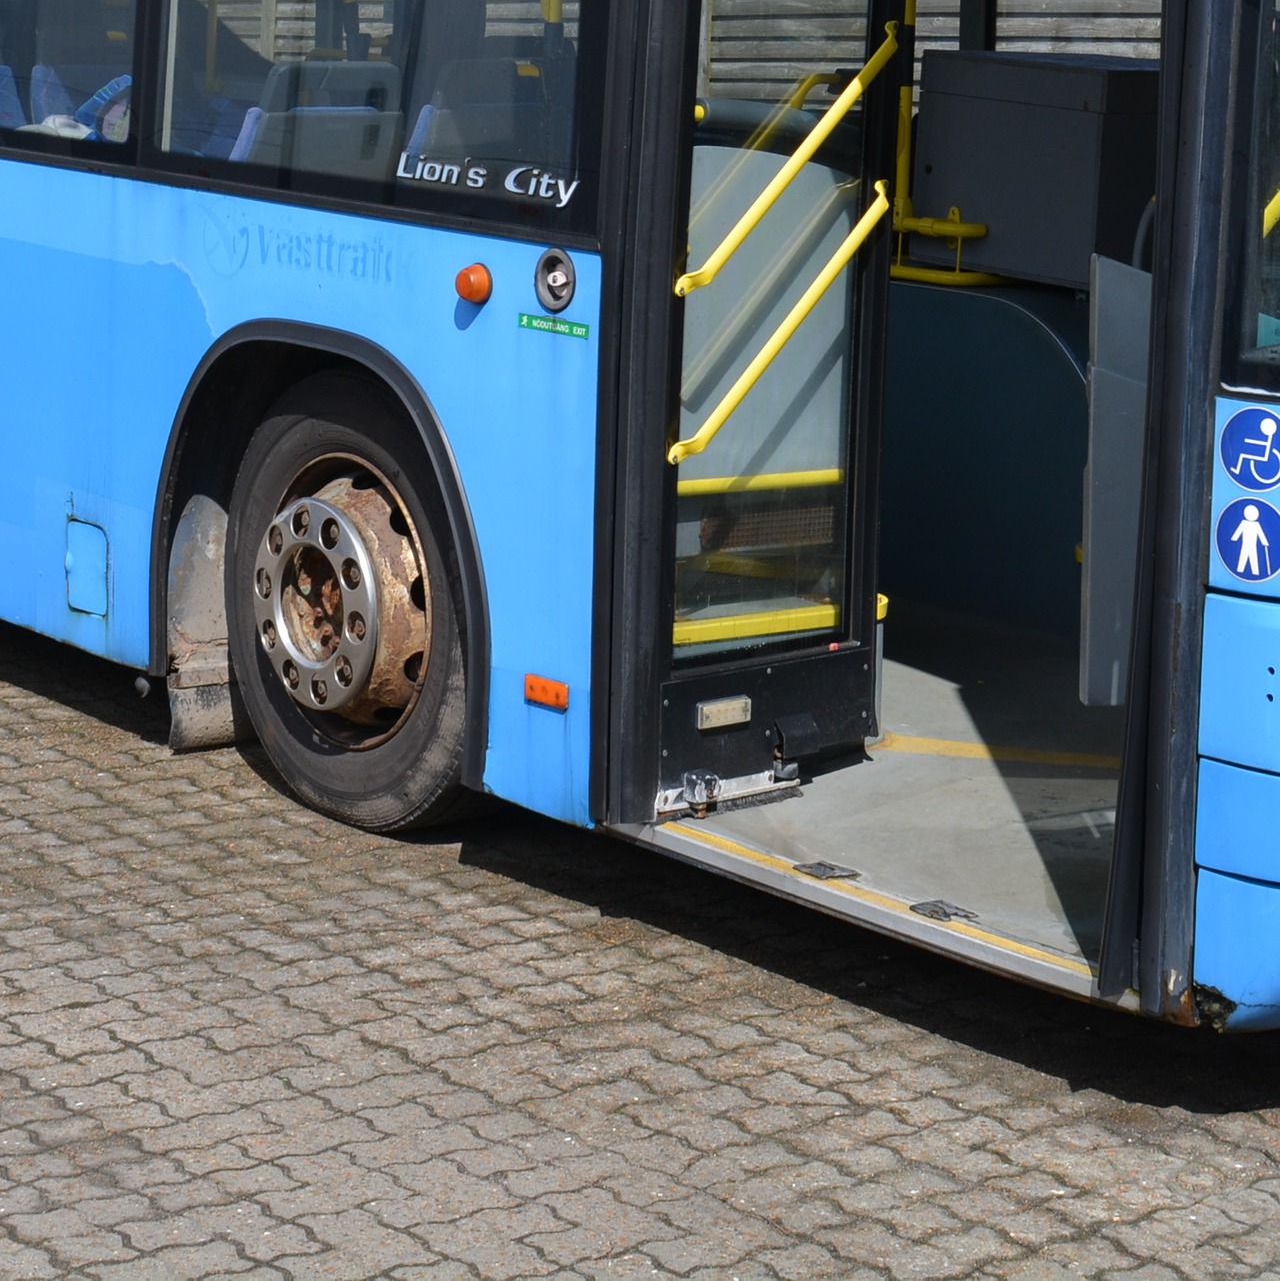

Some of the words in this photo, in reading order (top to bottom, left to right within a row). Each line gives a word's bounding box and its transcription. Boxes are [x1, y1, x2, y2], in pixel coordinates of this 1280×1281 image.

[396, 151, 487, 188] Lion's
[504, 166, 580, 208] City
[573, 326, 586, 336] EXIT
